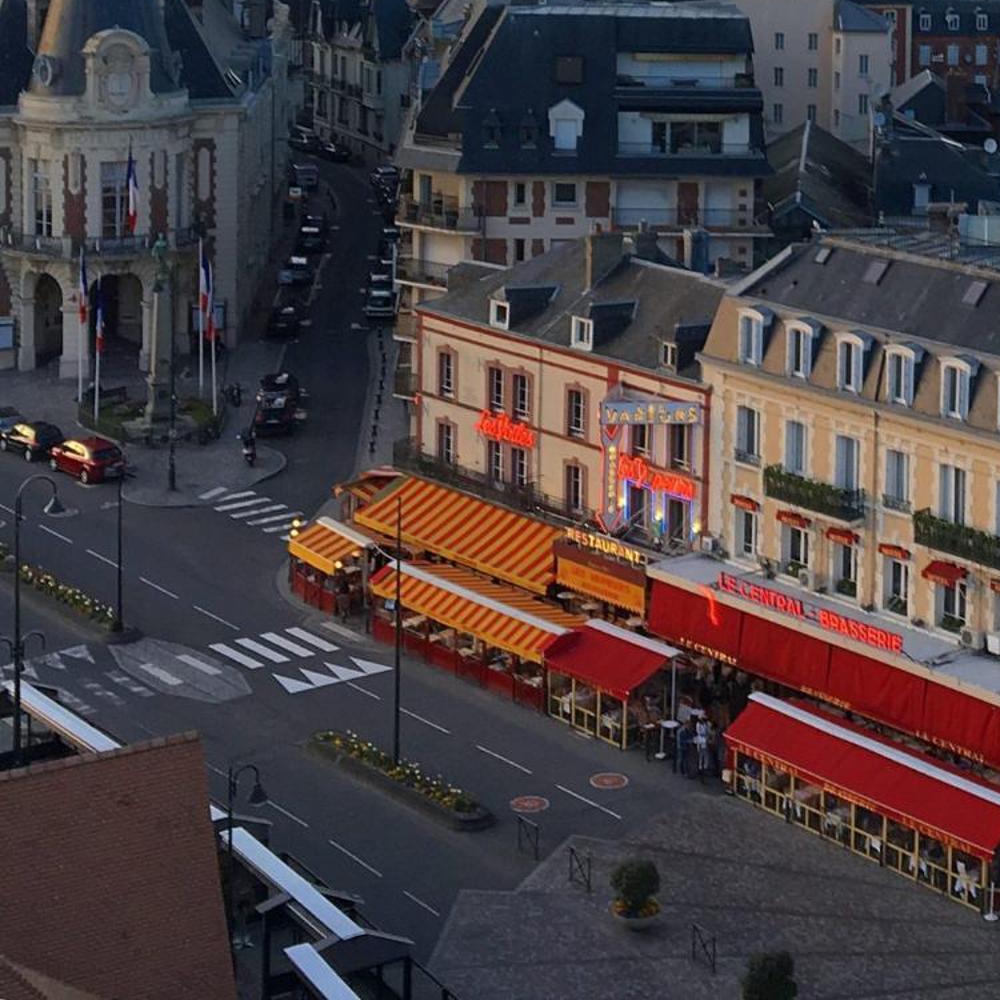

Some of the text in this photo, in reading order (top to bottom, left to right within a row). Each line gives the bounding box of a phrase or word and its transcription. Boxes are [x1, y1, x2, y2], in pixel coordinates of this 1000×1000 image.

[565, 527, 641, 564] RESTAURANT
[717, 572, 738, 594] LE
[739, 582, 804, 620] CENTRAL
[819, 609, 903, 653] BRASSERIE
